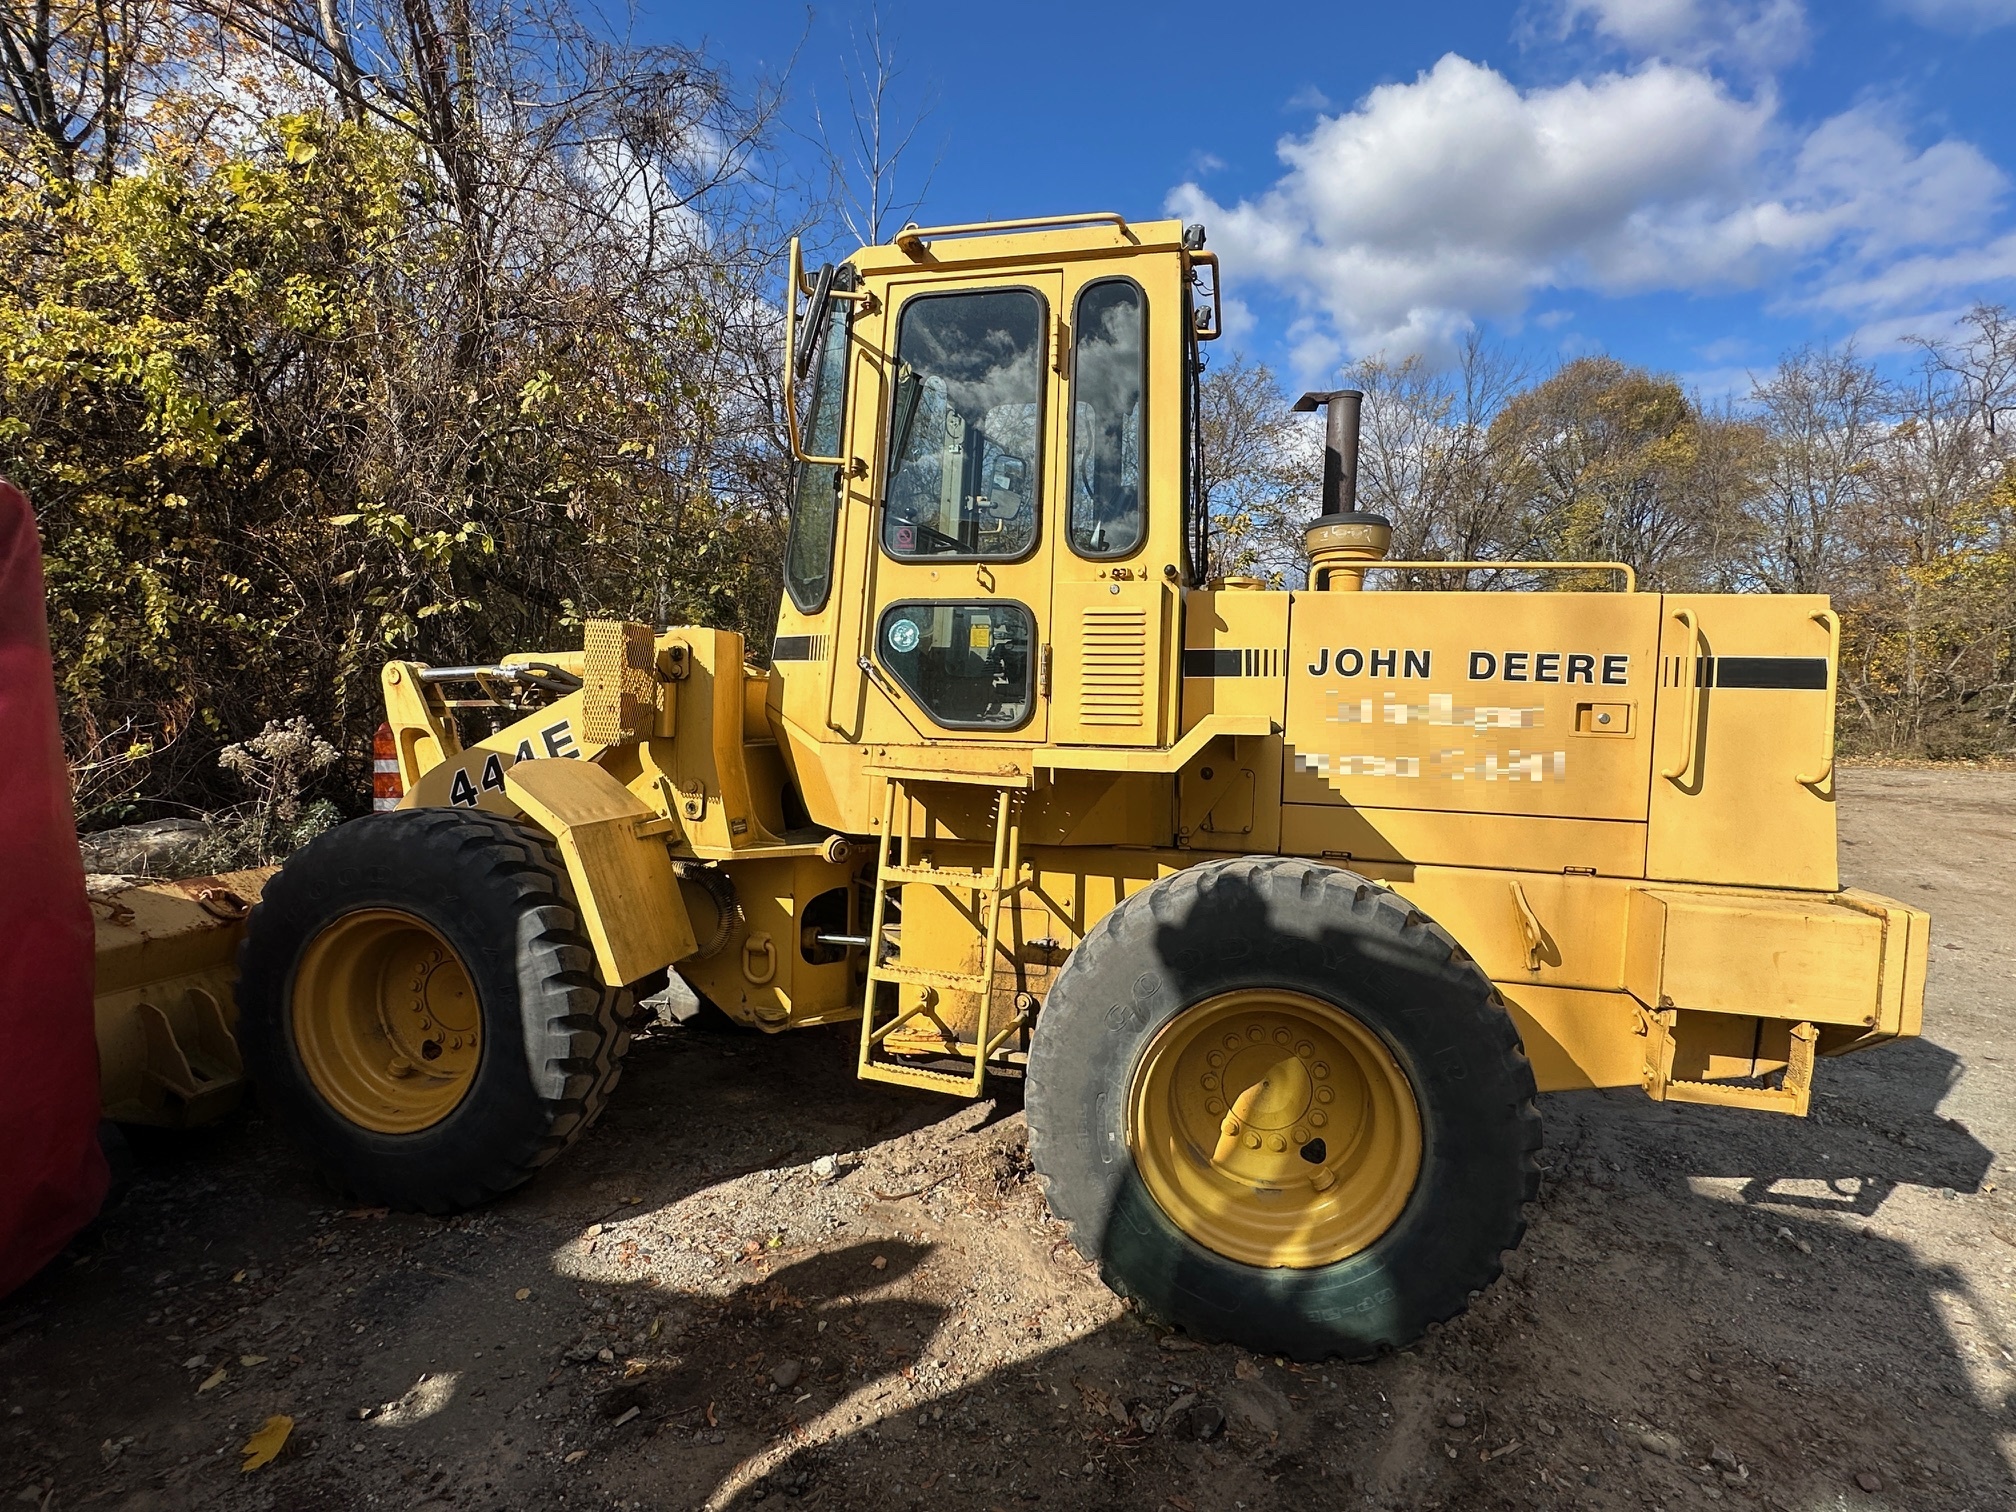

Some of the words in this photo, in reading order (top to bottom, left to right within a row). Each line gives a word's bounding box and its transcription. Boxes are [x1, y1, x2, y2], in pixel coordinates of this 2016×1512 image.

[1307, 647, 1432, 679] JOHN
[1468, 650, 1630, 686] DEERE
[1104, 936, 1468, 1081] GOODYEAR
